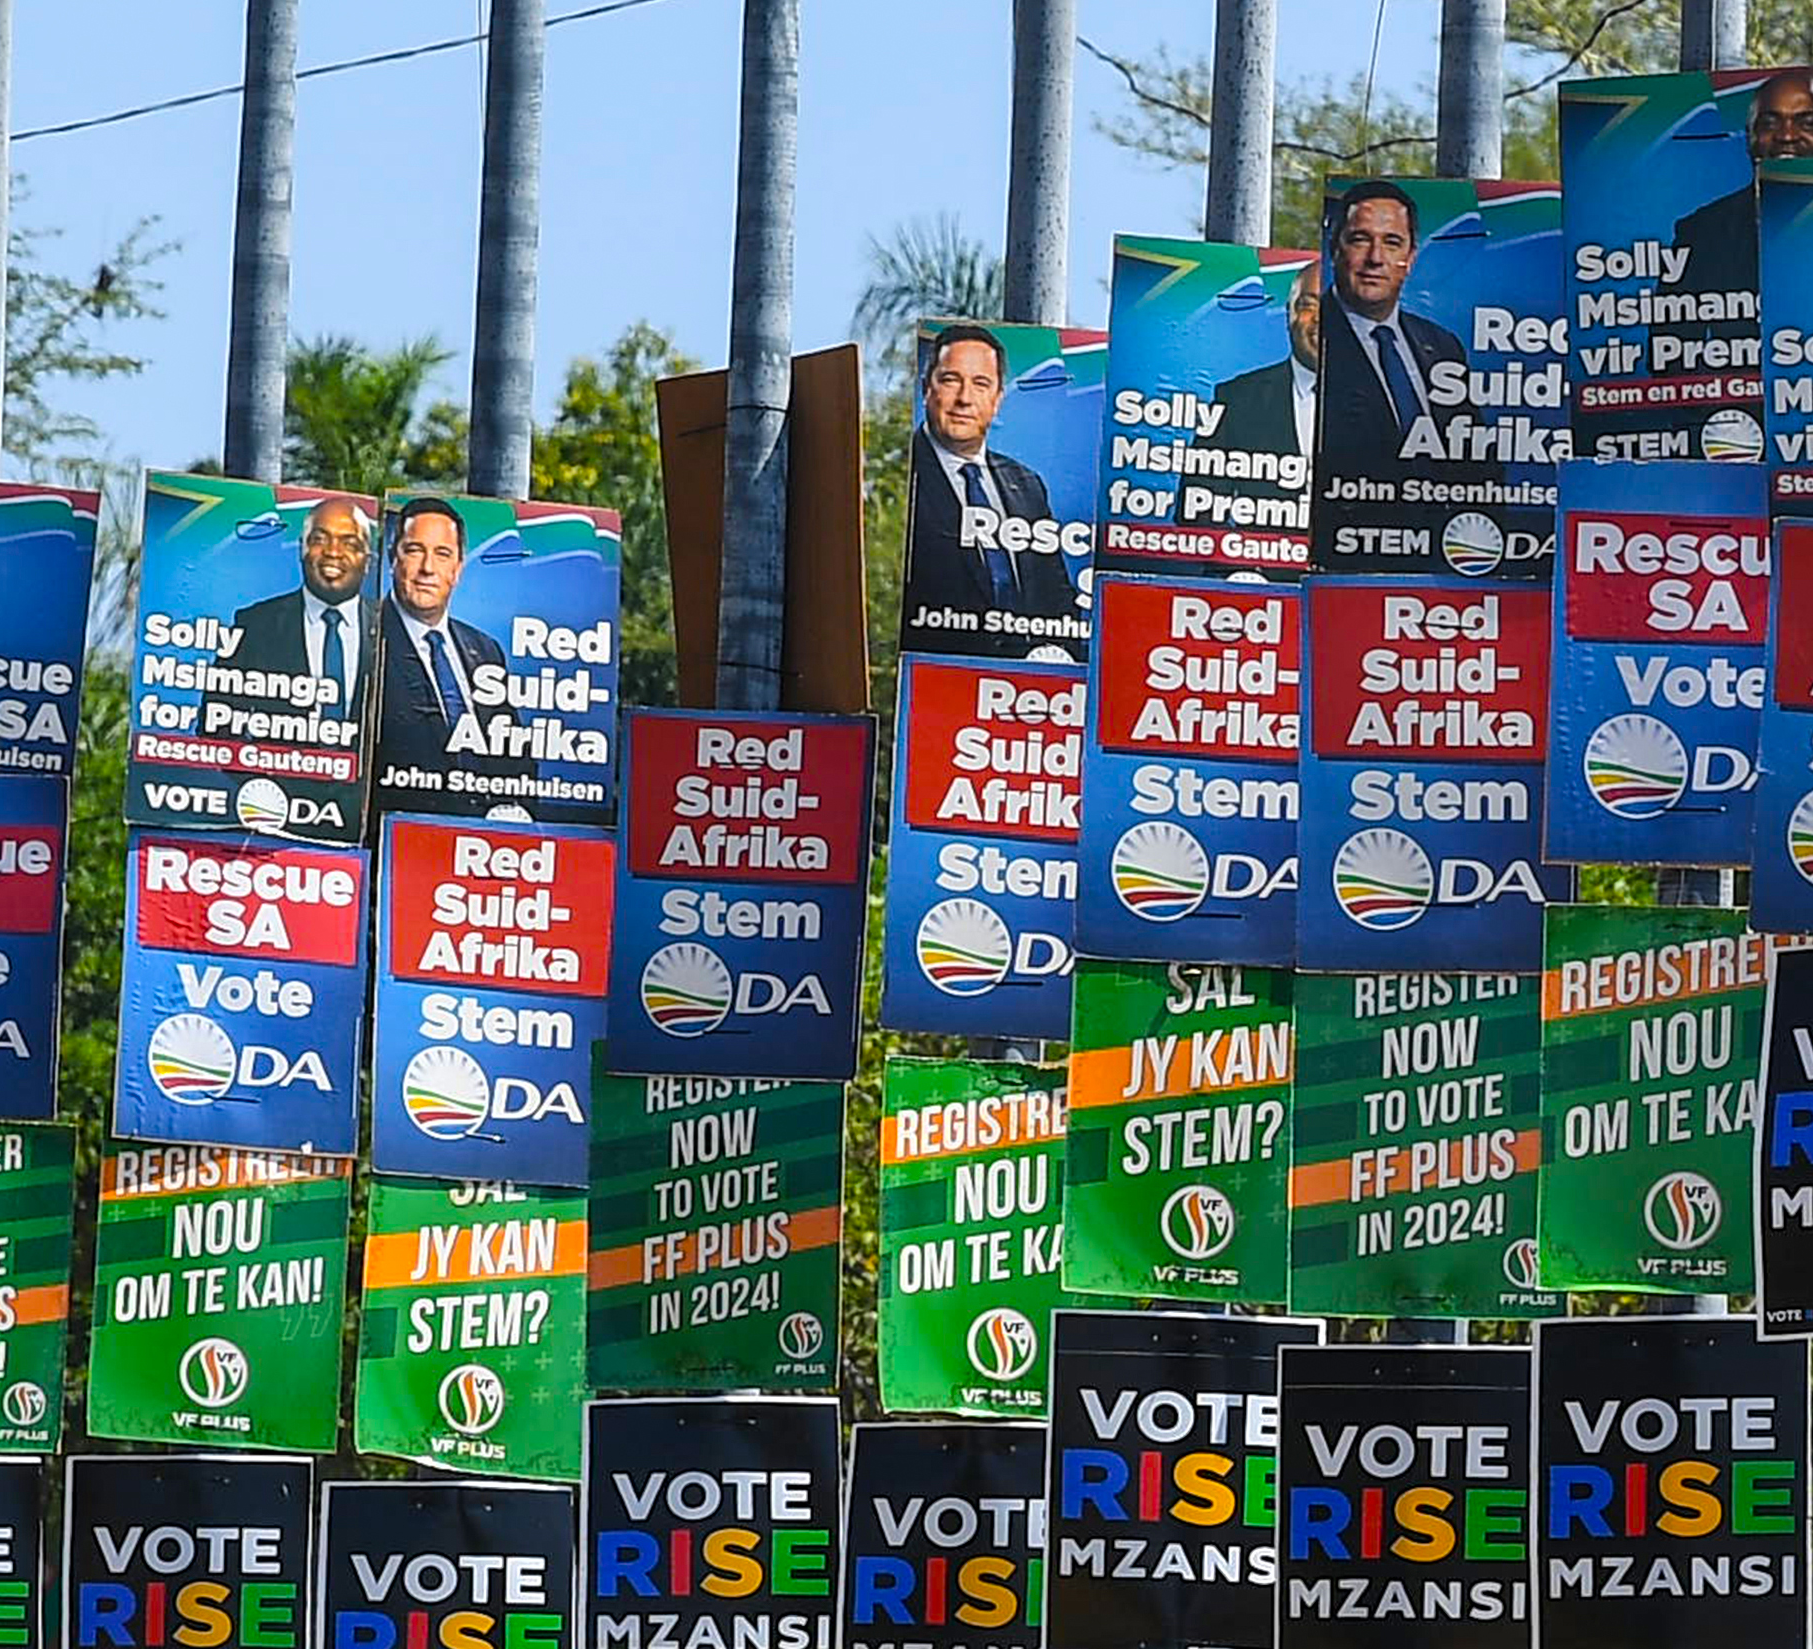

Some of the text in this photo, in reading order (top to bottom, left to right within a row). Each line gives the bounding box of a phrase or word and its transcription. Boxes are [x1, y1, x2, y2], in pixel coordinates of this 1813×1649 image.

[145, 614, 243, 660] Solly
[1383, 596, 1499, 640] Red
[143, 656, 339, 704] Msimanga
[1359, 649, 1521, 695] Suid-
[139, 696, 358, 746] for Premier
[1347, 702, 1535, 748] Afrika
[137, 734, 352, 780] Rescue Gauteng
[143, 784, 345, 828] VOTE DA
[1349, 770, 1528, 821] Stem
[1437, 860, 1546, 904] DA
[1767, 1309, 1802, 1321] VOTE
[18, 1429, 48, 1441] PLUS
